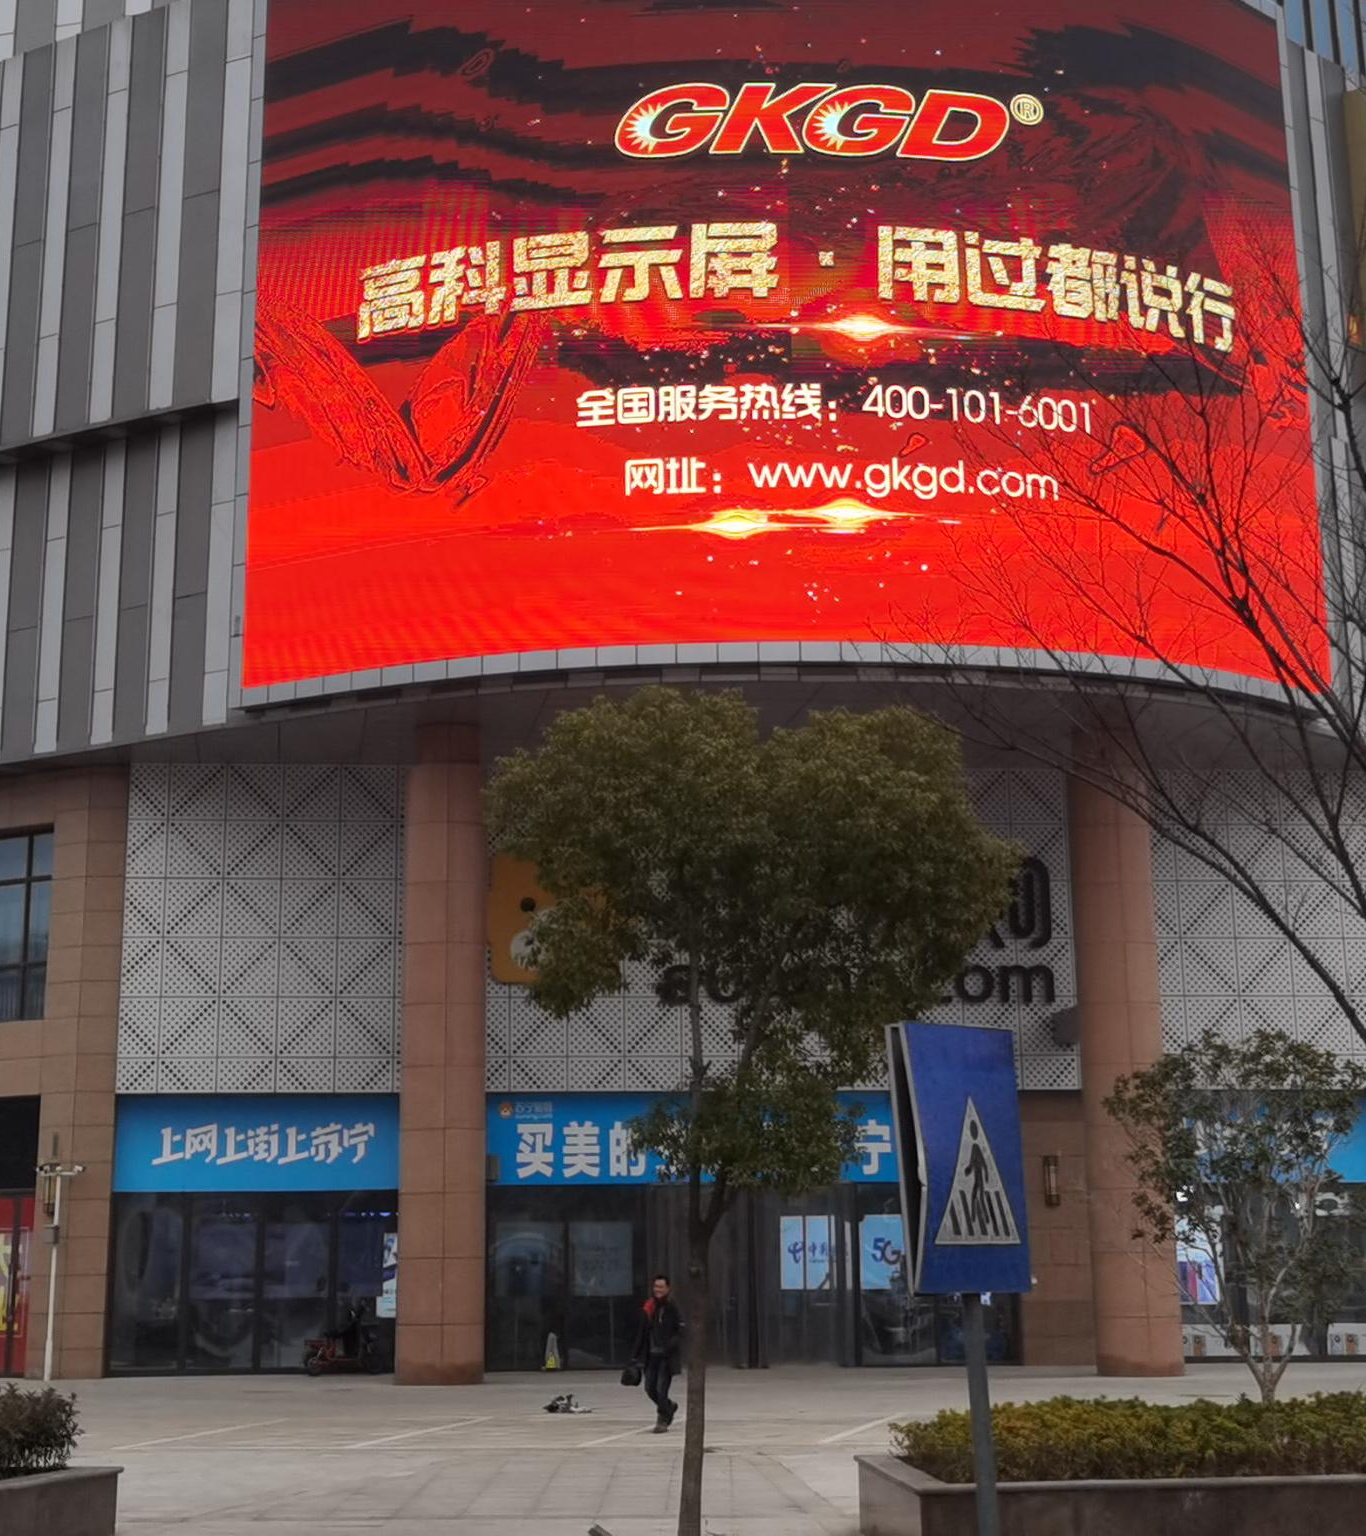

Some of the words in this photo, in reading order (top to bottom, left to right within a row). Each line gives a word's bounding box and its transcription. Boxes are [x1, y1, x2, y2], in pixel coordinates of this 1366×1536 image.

[615, 82, 1011, 162] GKGD
[355, 222, 778, 344] 高科显示屏
[876, 224, 1236, 355] 用过都说行
[861, 384, 1093, 435] 400-101-6001
[747, 457, 1060, 503] www.gkgd.com
[151, 1122, 376, 1166] 上网上街上苏宁
[871, 1237, 902, 1265] 5G
